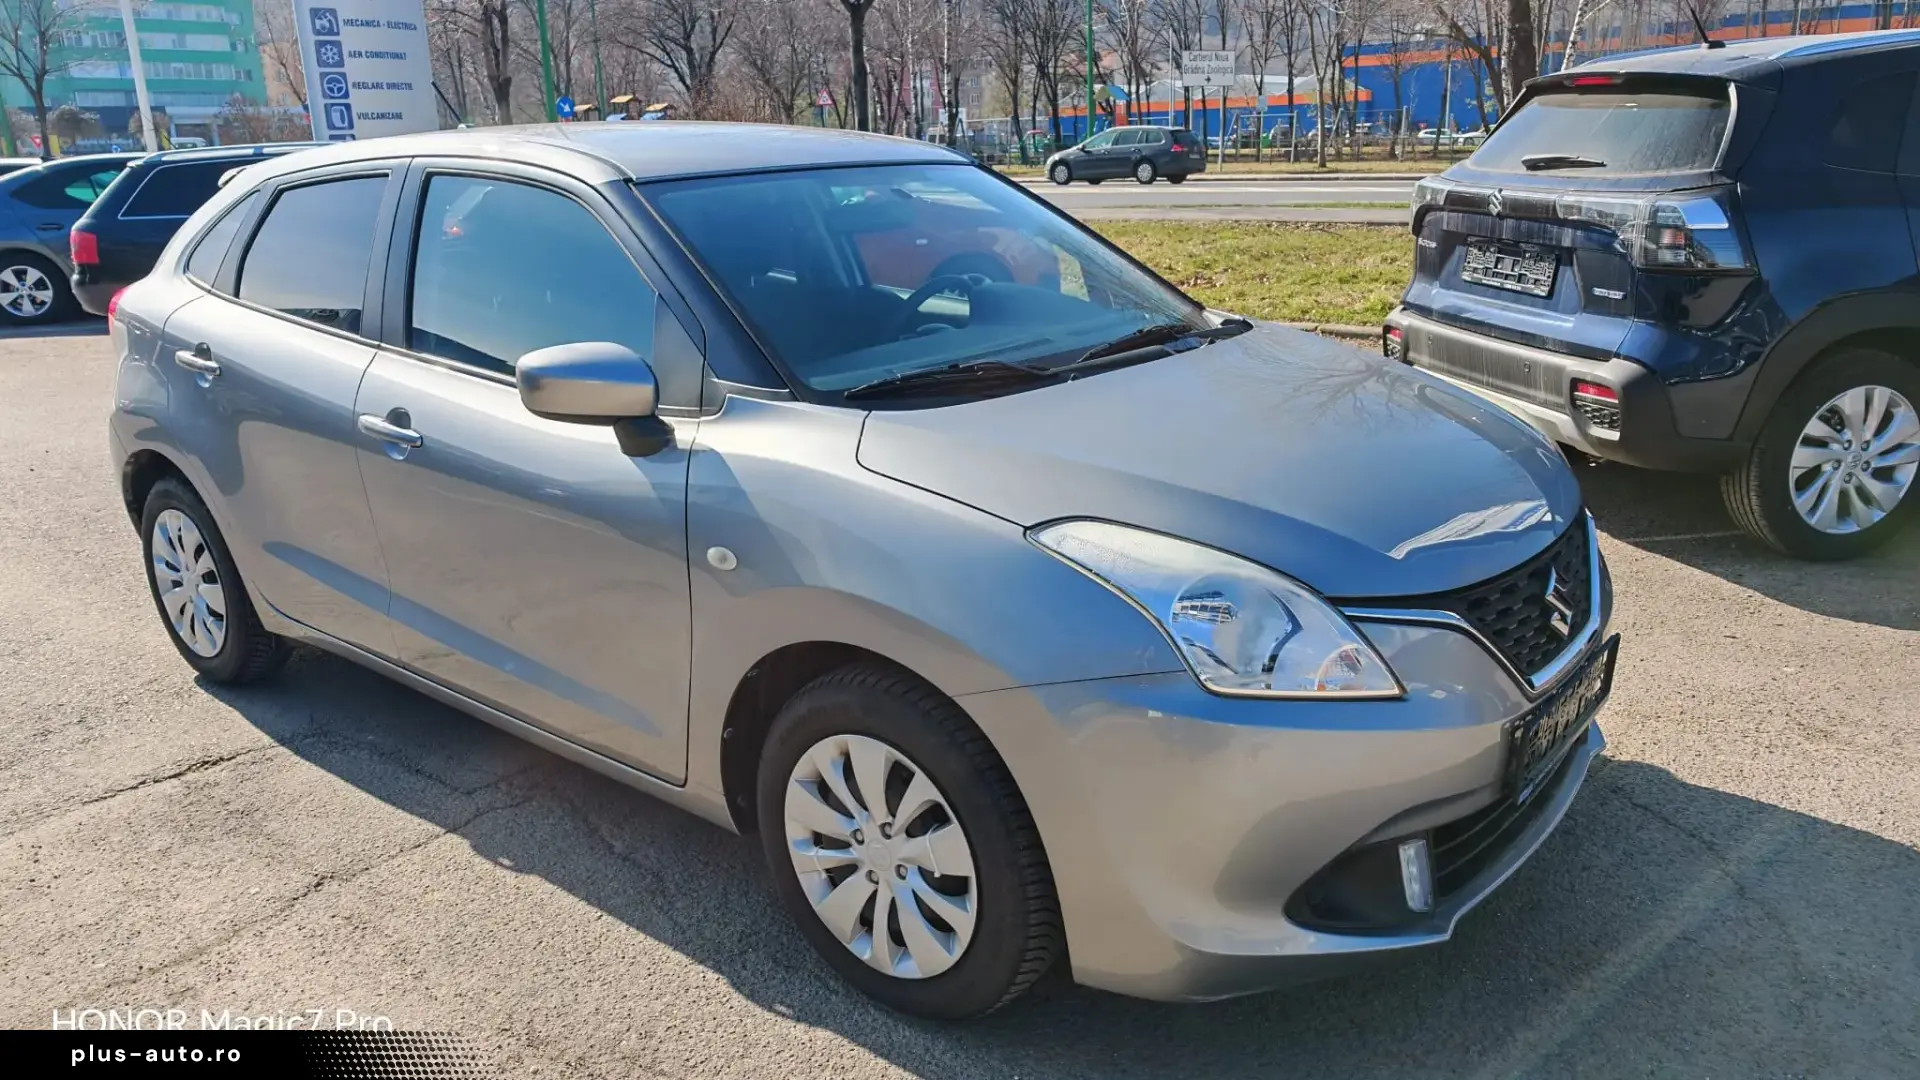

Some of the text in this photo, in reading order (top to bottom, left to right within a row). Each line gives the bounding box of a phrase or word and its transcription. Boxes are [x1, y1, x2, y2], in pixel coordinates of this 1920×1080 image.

[343, 18, 381, 28] MECANICA
[348, 50, 363, 59] AER
[352, 81, 385, 90] REGLARE
[356, 112, 403, 120] VULCANIZARE
